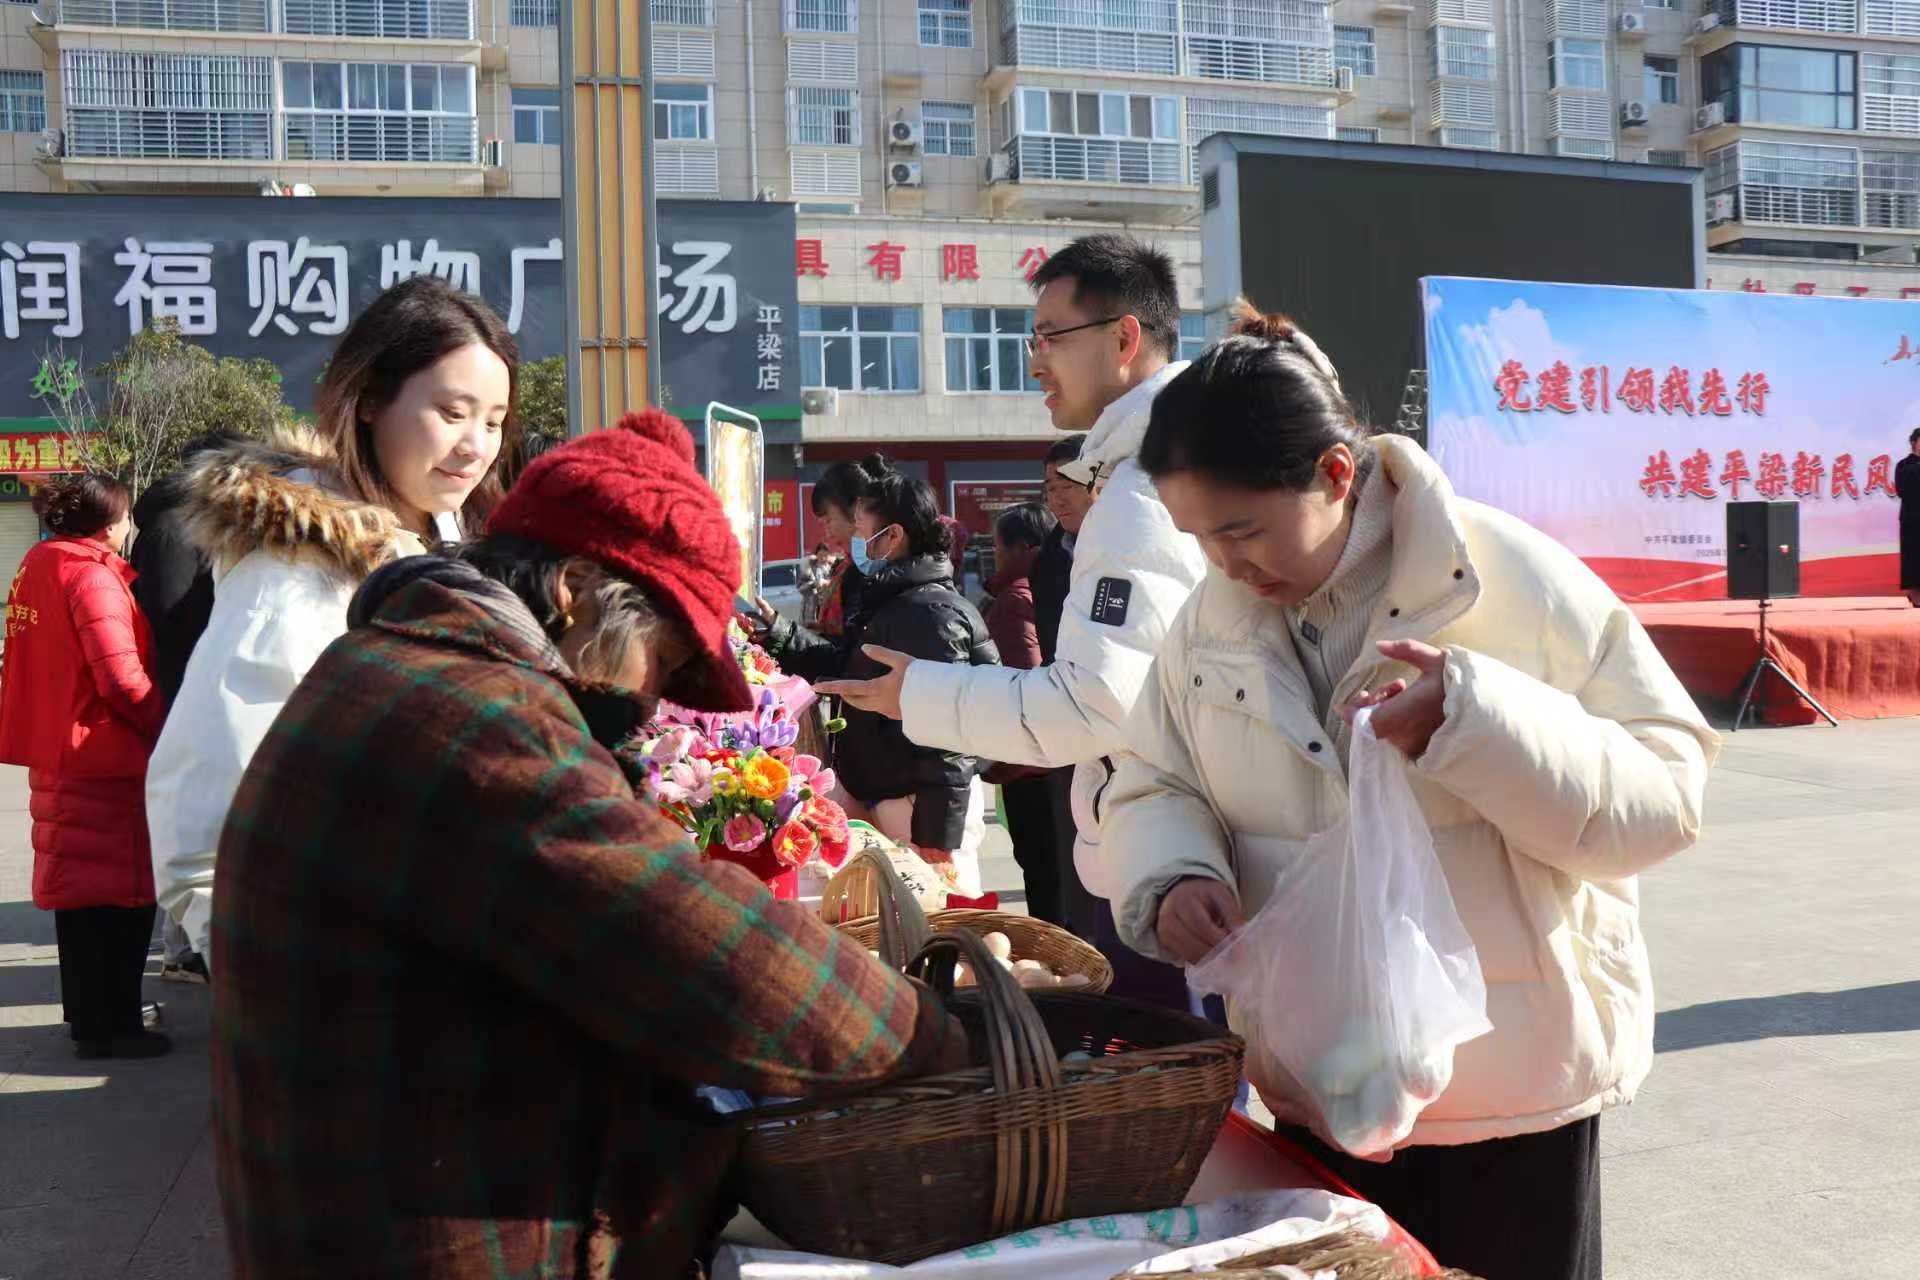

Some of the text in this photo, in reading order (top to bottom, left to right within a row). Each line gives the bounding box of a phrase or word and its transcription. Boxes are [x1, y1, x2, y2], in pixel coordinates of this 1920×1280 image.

[0, 237, 737, 338] 润福购物广场
[756, 305, 782, 391] 平梁店
[1494, 359, 1770, 416] 党建引领我先行
[1639, 447, 1899, 500] 共建平梁新民风
